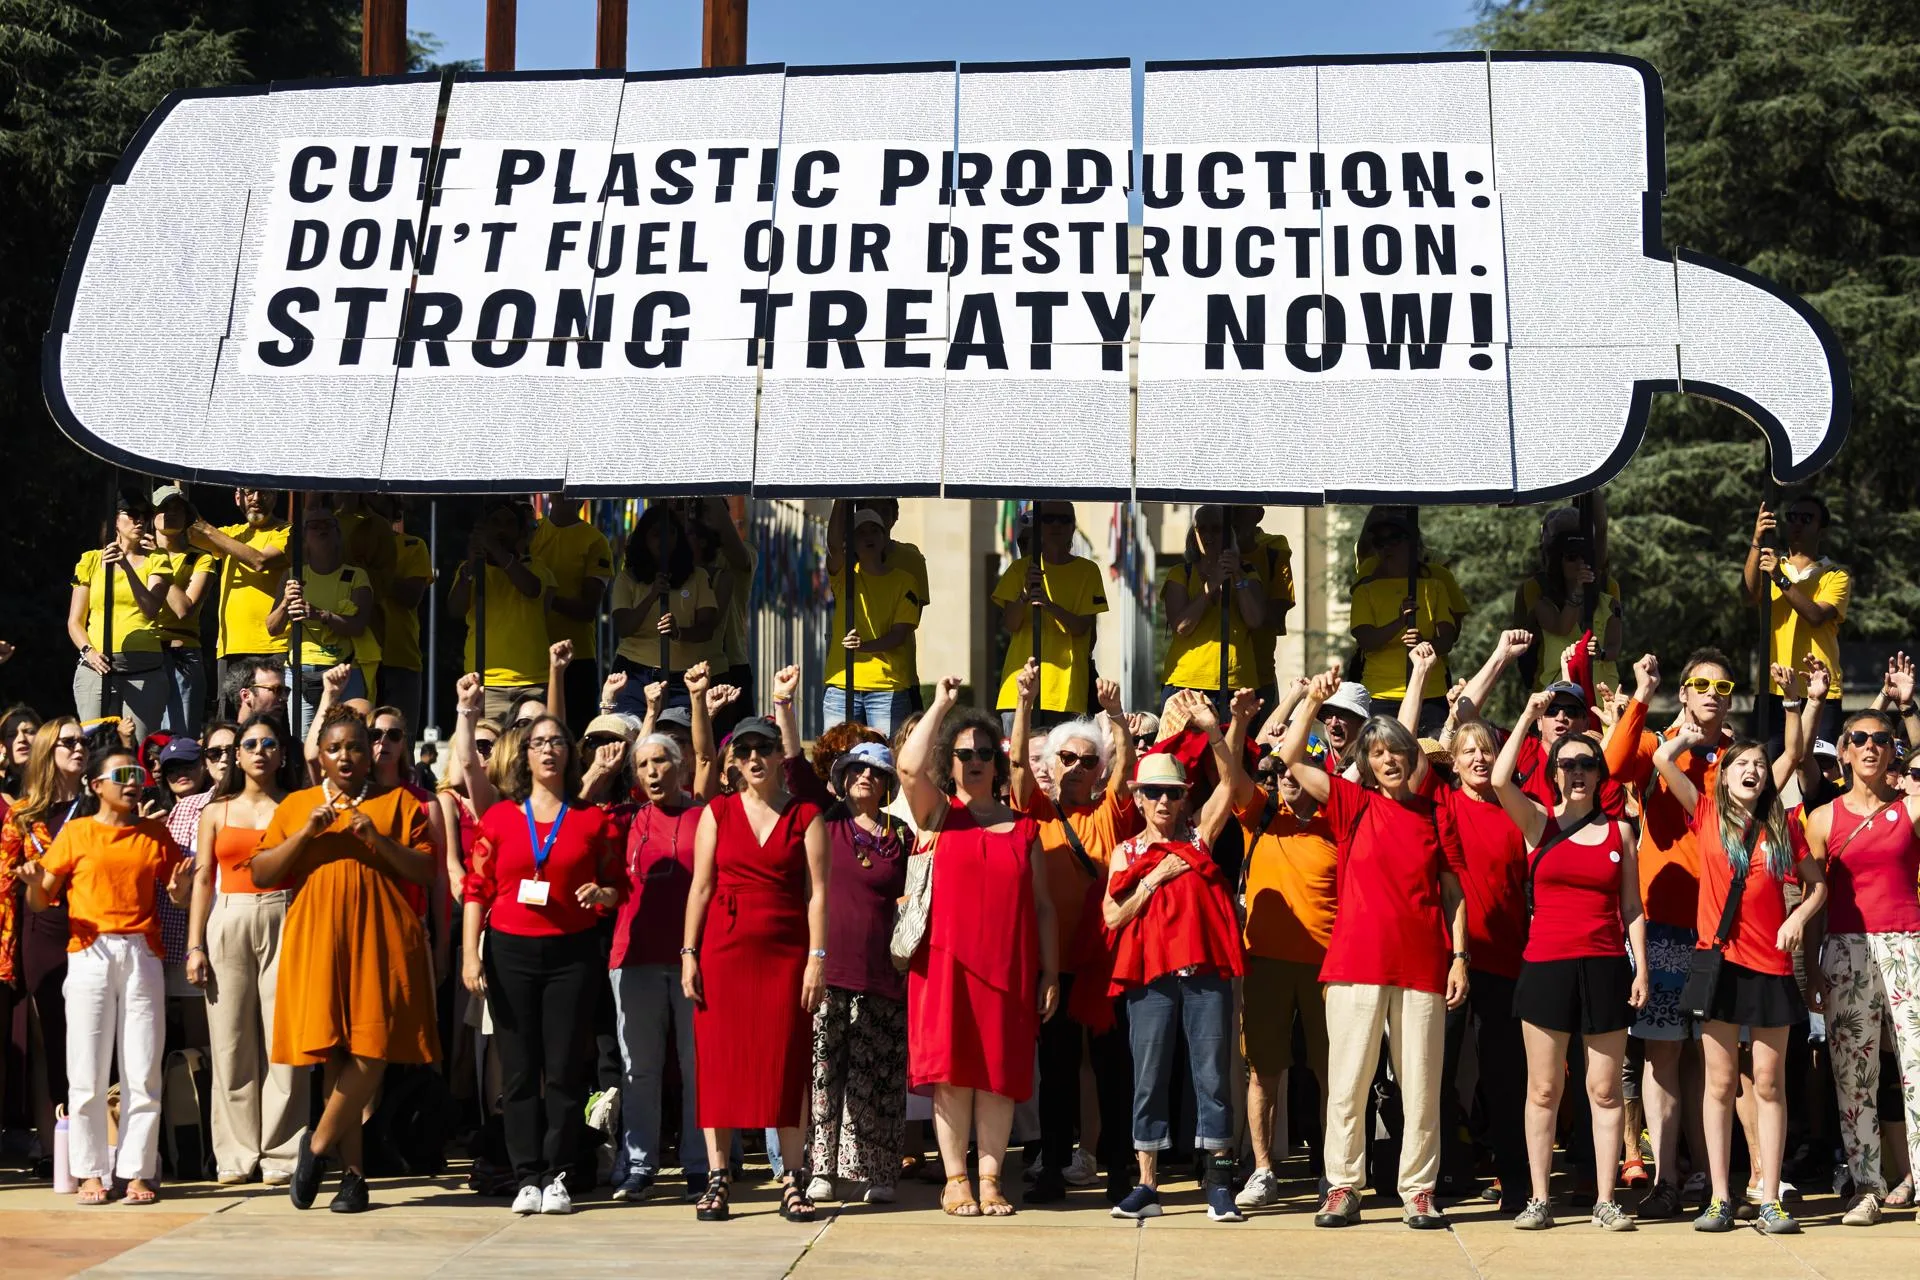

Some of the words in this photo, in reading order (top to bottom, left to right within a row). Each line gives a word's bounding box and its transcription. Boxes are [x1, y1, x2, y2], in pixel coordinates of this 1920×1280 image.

[289, 145, 461, 206] CUT
[495, 147, 840, 208] PLASTIC
[880, 148, 1491, 210] PRODUCTION:
[546, 221, 708, 278] FUEL
[744, 220, 891, 277] OUR
[927, 222, 1488, 278] DESTRUCTION.
[258, 286, 690, 370] STRONG
[739, 288, 1156, 371] TREATY
[1205, 292, 1493, 373] NOW!
